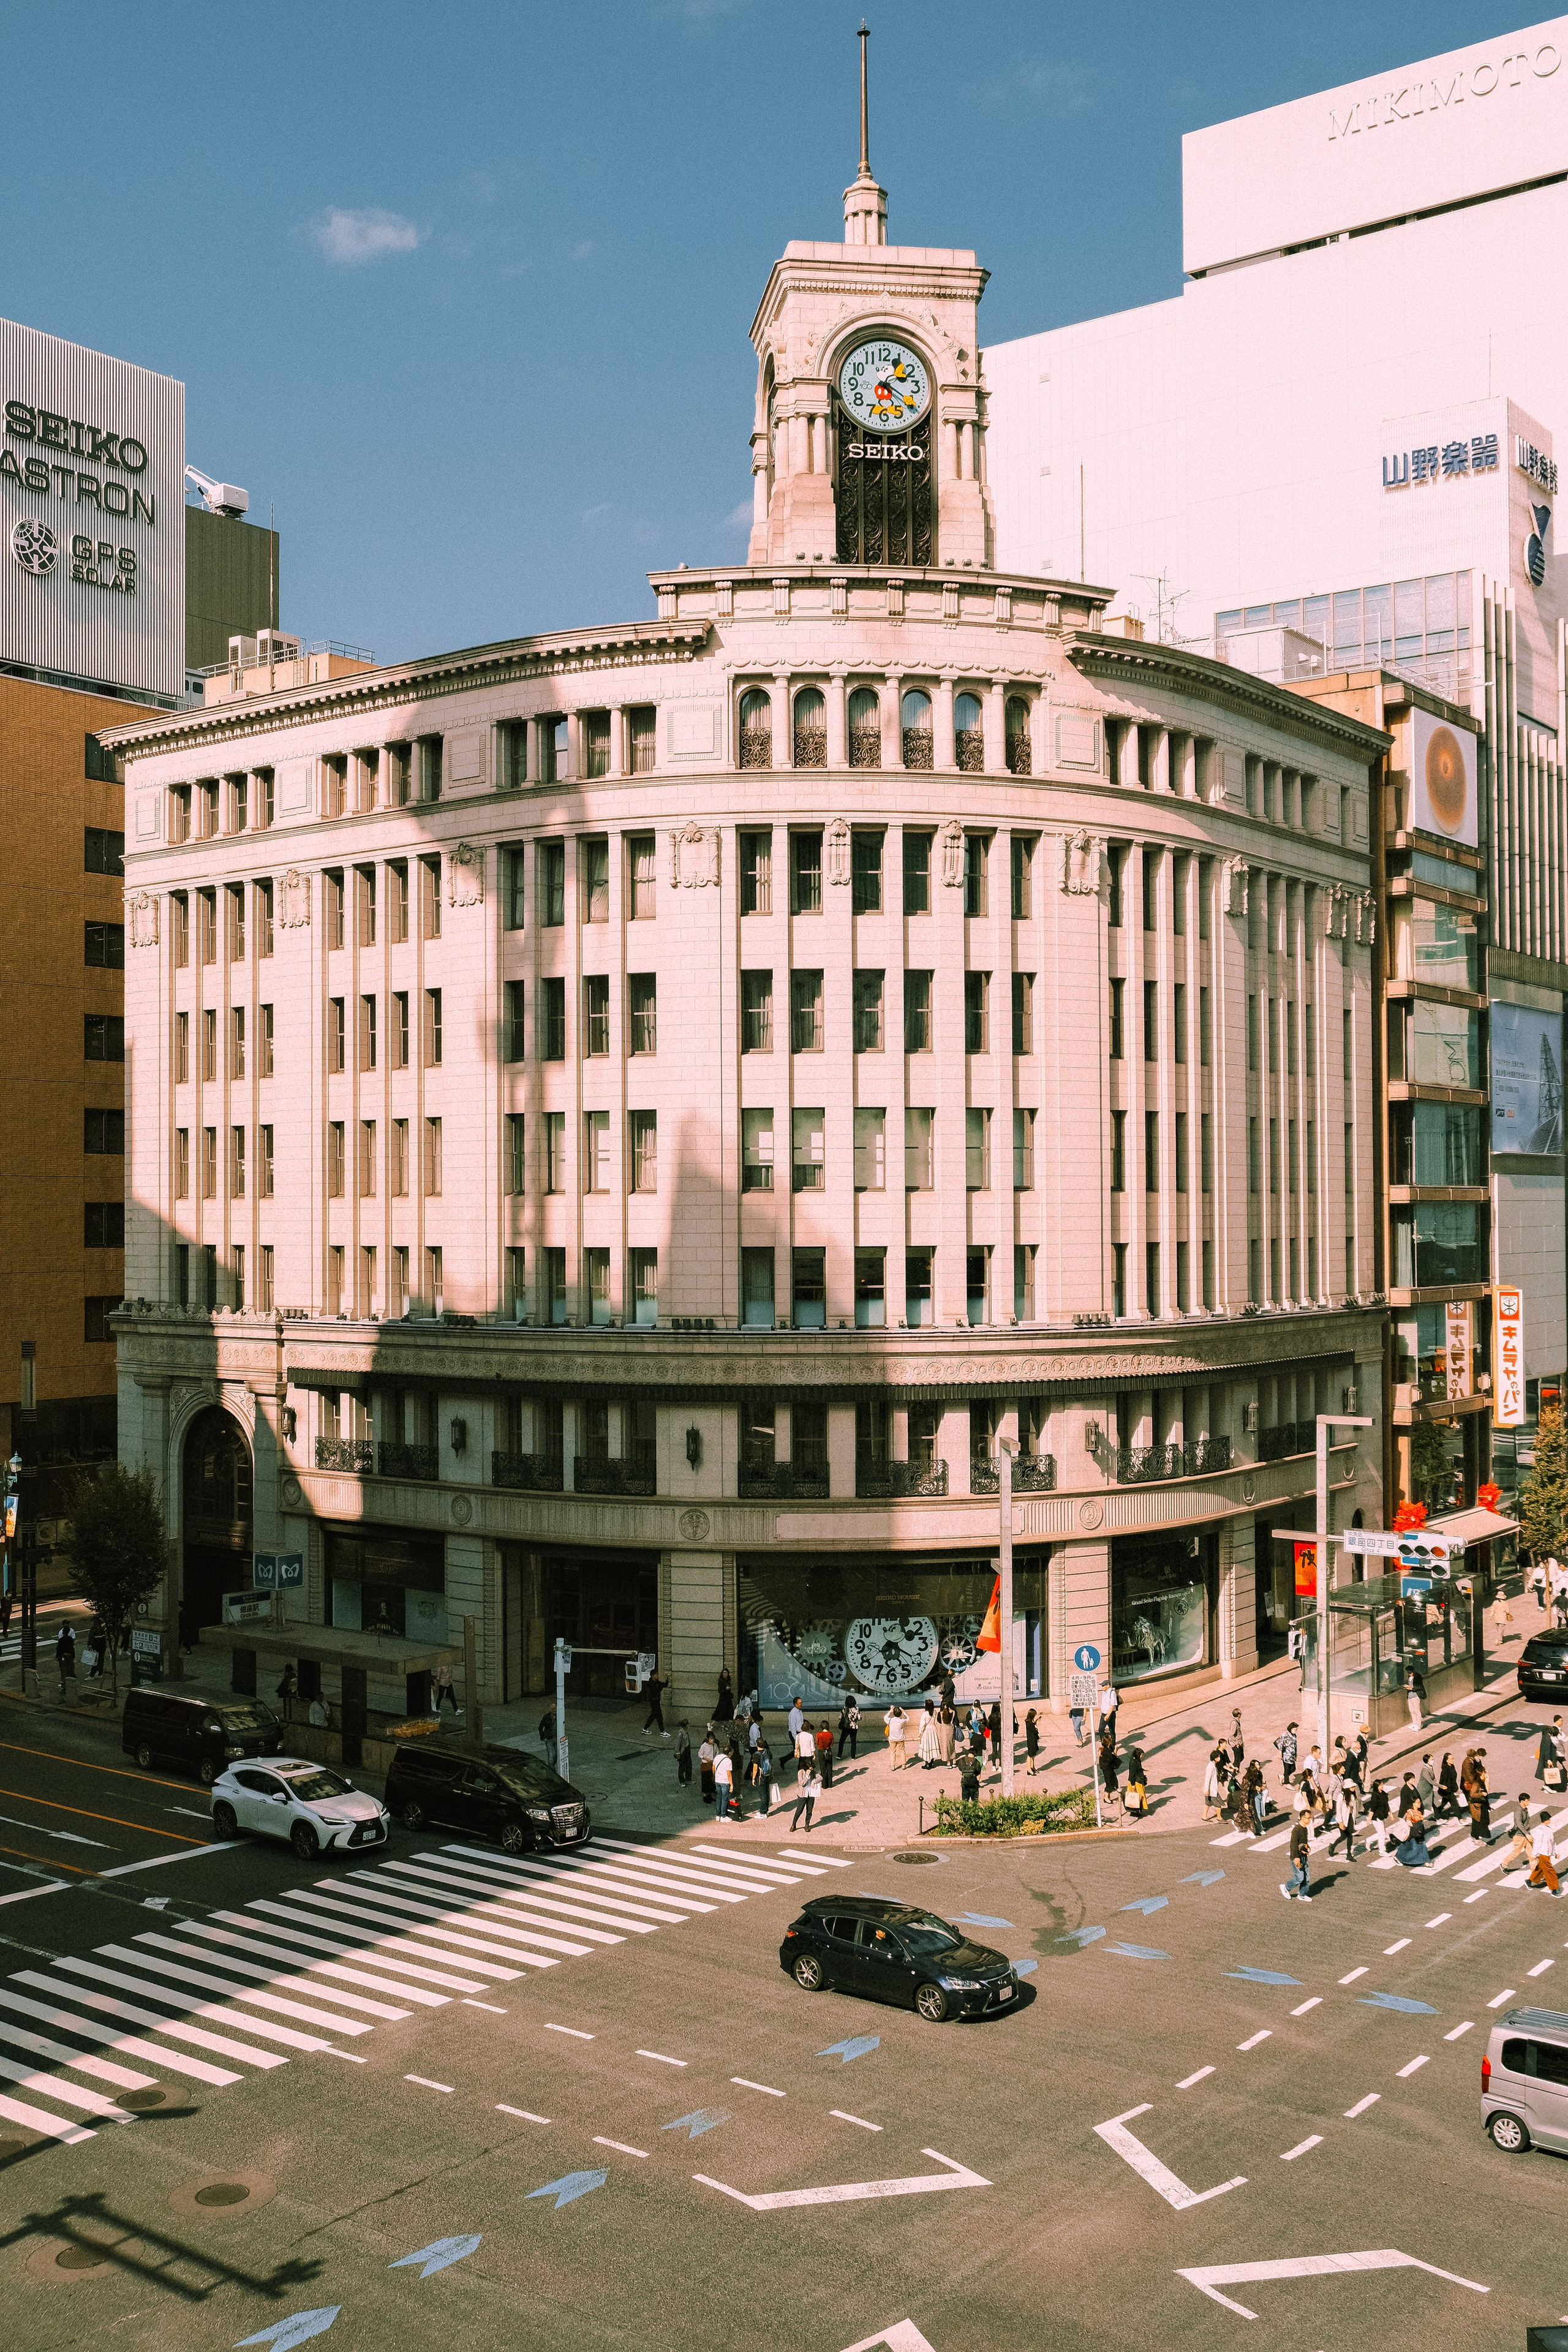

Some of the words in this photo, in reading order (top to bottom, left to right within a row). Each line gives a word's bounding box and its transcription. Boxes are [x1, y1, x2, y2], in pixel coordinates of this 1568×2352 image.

[1328, 43, 1562, 141] MIKIMOTO
[865, 351, 875, 365] 11
[878, 347, 891, 362] 12
[852, 361, 865, 376] 10
[906, 364, 916, 378] 2
[848, 376, 858, 391] 9
[910, 379, 921, 394] 3
[853, 392, 864, 407] 8
[879, 409, 890, 423] 6
[895, 405, 904, 419] 5
[3, 400, 148, 473] SEIKO
[849, 443, 924, 461] SEIKO
[1383, 433, 1499, 486] 山野楽器
[0, 449, 155, 526] ASTRON
[69, 534, 137, 574] GPS
[70, 563, 136, 594] SOLAR
[1502, 1325, 1520, 1417] キムラヤのパン
[1348, 1536, 1394, 1550] 銀座四丁目
[240, 1604, 259, 1613] 銀座駅
[859, 1623, 872, 1638] 10
[913, 1621, 923, 1635] 2
[854, 1639, 865, 1654] 9
[918, 1637, 929, 1651] 3
[860, 1654, 871, 1669] 8
[873, 1665, 884, 1679] 7
[886, 1668, 897, 1683] 6
[900, 1664, 911, 1679] 5
